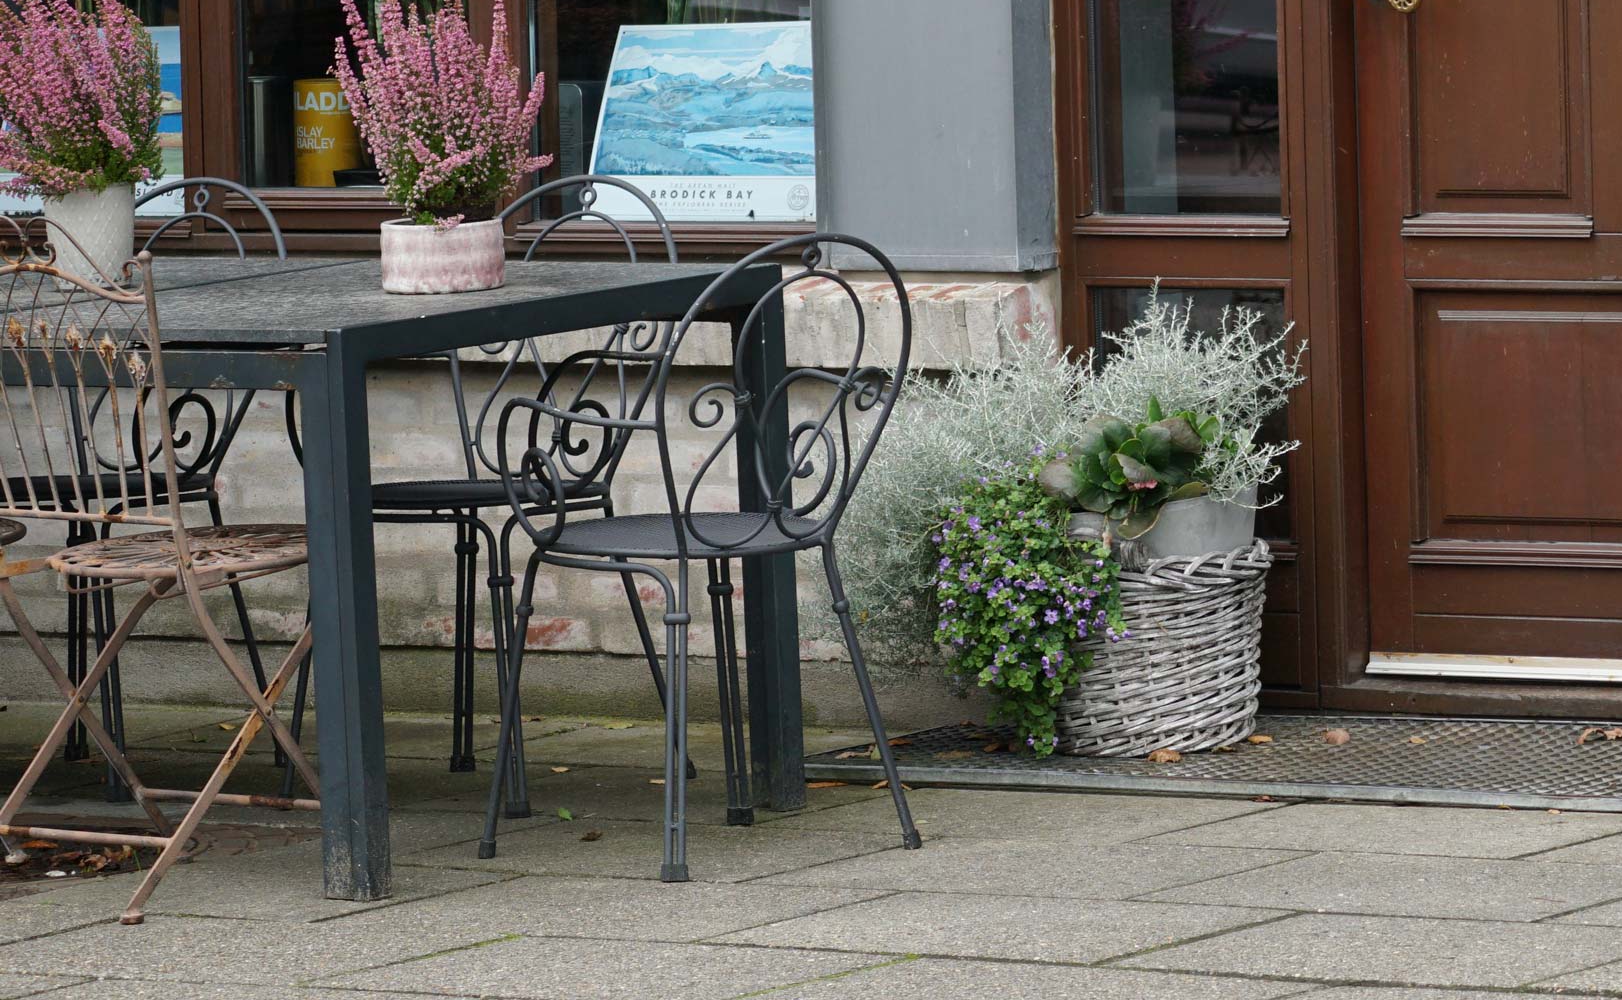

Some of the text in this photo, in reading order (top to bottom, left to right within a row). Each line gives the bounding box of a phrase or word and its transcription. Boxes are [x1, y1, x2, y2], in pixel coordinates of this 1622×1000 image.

[297, 126, 323, 137] ISLAY
[297, 138, 335, 149] BARLEY
[650, 190, 753, 200] BRODICK BAY
